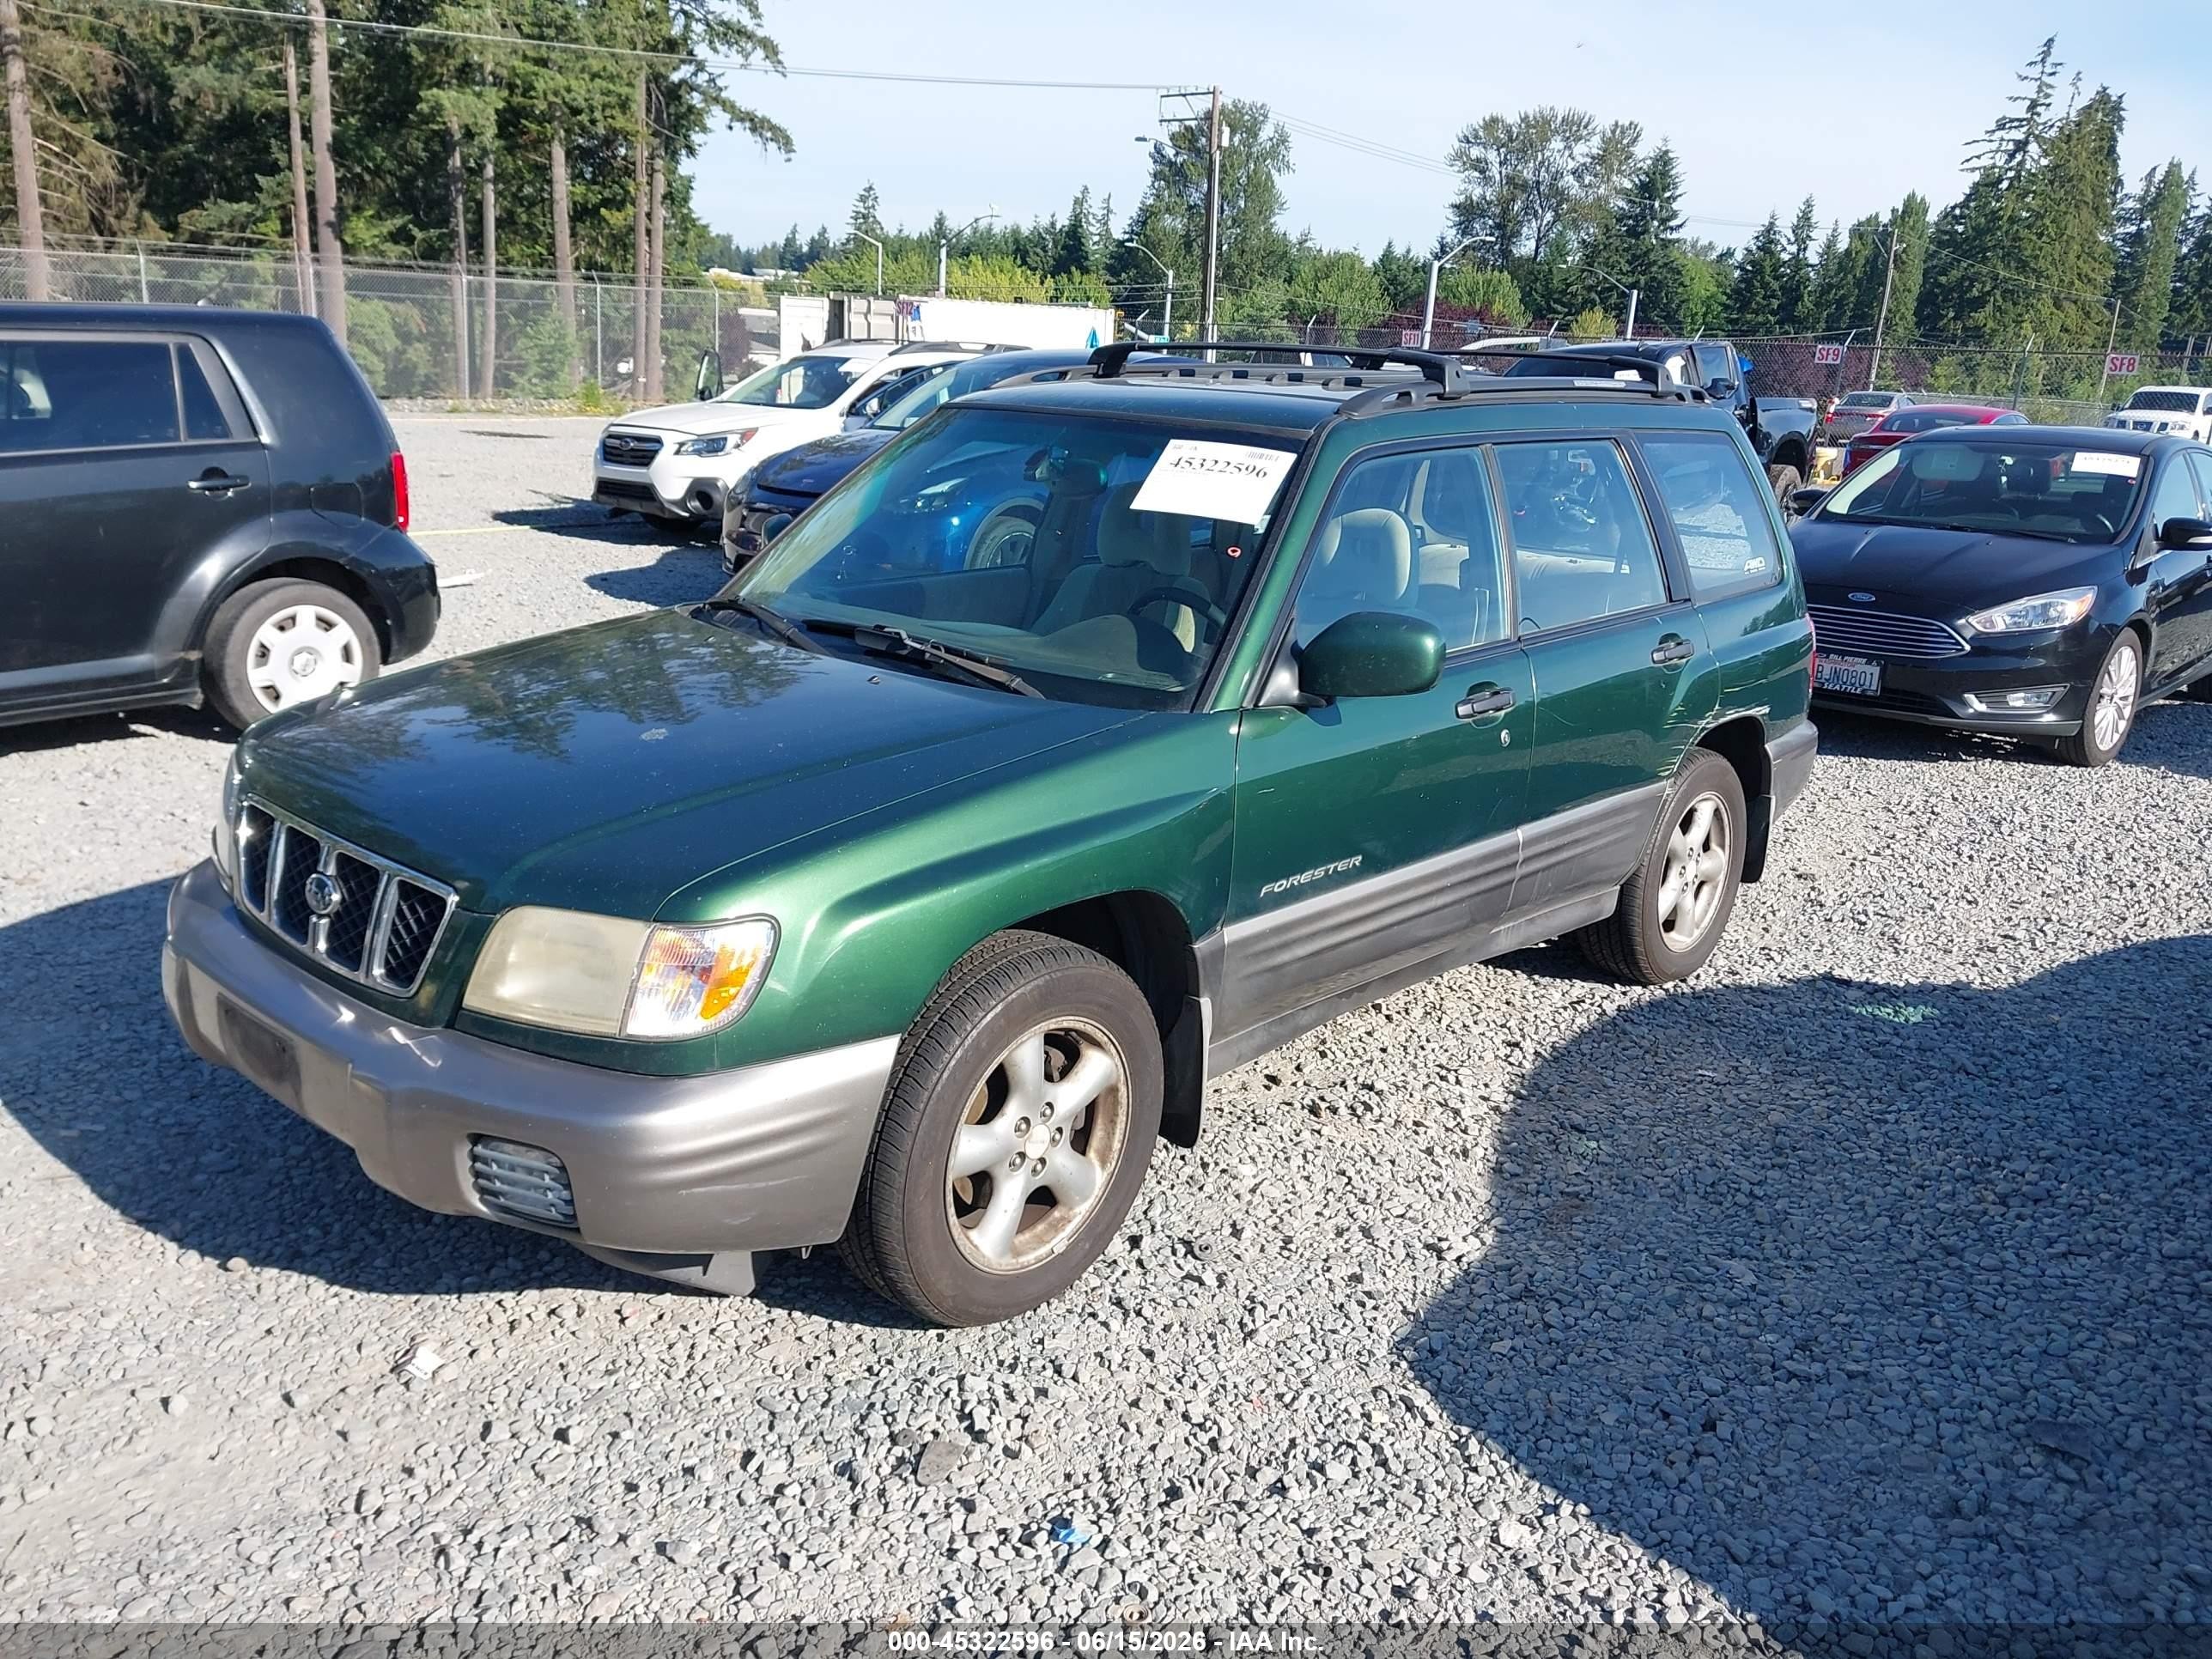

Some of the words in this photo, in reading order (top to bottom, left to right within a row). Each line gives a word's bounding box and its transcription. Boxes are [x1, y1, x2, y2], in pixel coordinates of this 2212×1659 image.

[896, 301, 913, 315] SF12
[1403, 332, 1419, 345] SF11
[1817, 347, 1840, 362] SF9
[2109, 356, 2136, 372] SF8
[1170, 455, 1268, 478] 45322596
[1815, 664, 1873, 689] BJN0801
[1822, 682, 1863, 694] SEATTLE
[1260, 854, 1363, 898] FORESTER
